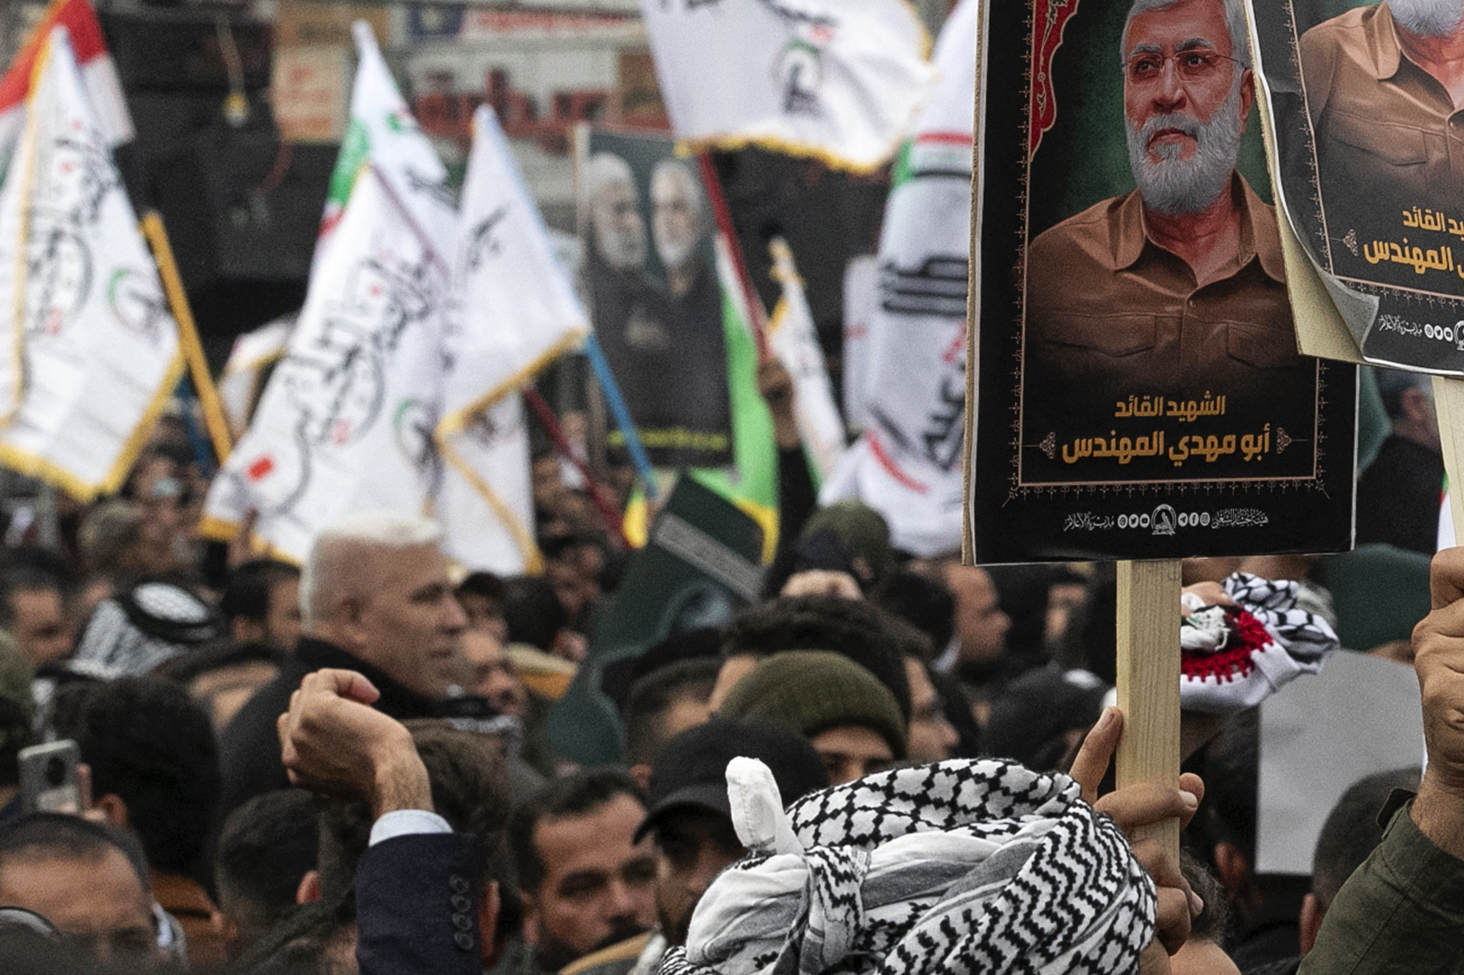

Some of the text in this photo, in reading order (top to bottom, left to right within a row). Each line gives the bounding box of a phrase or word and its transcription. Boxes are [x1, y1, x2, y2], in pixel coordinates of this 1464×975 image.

[1402, 206, 1447, 232] القائد
[1363, 238, 1454, 274] المهندس
[1114, 390, 1226, 422] الشهيد القائد
[1062, 423, 1271, 467] أبو مهدي المهندس
